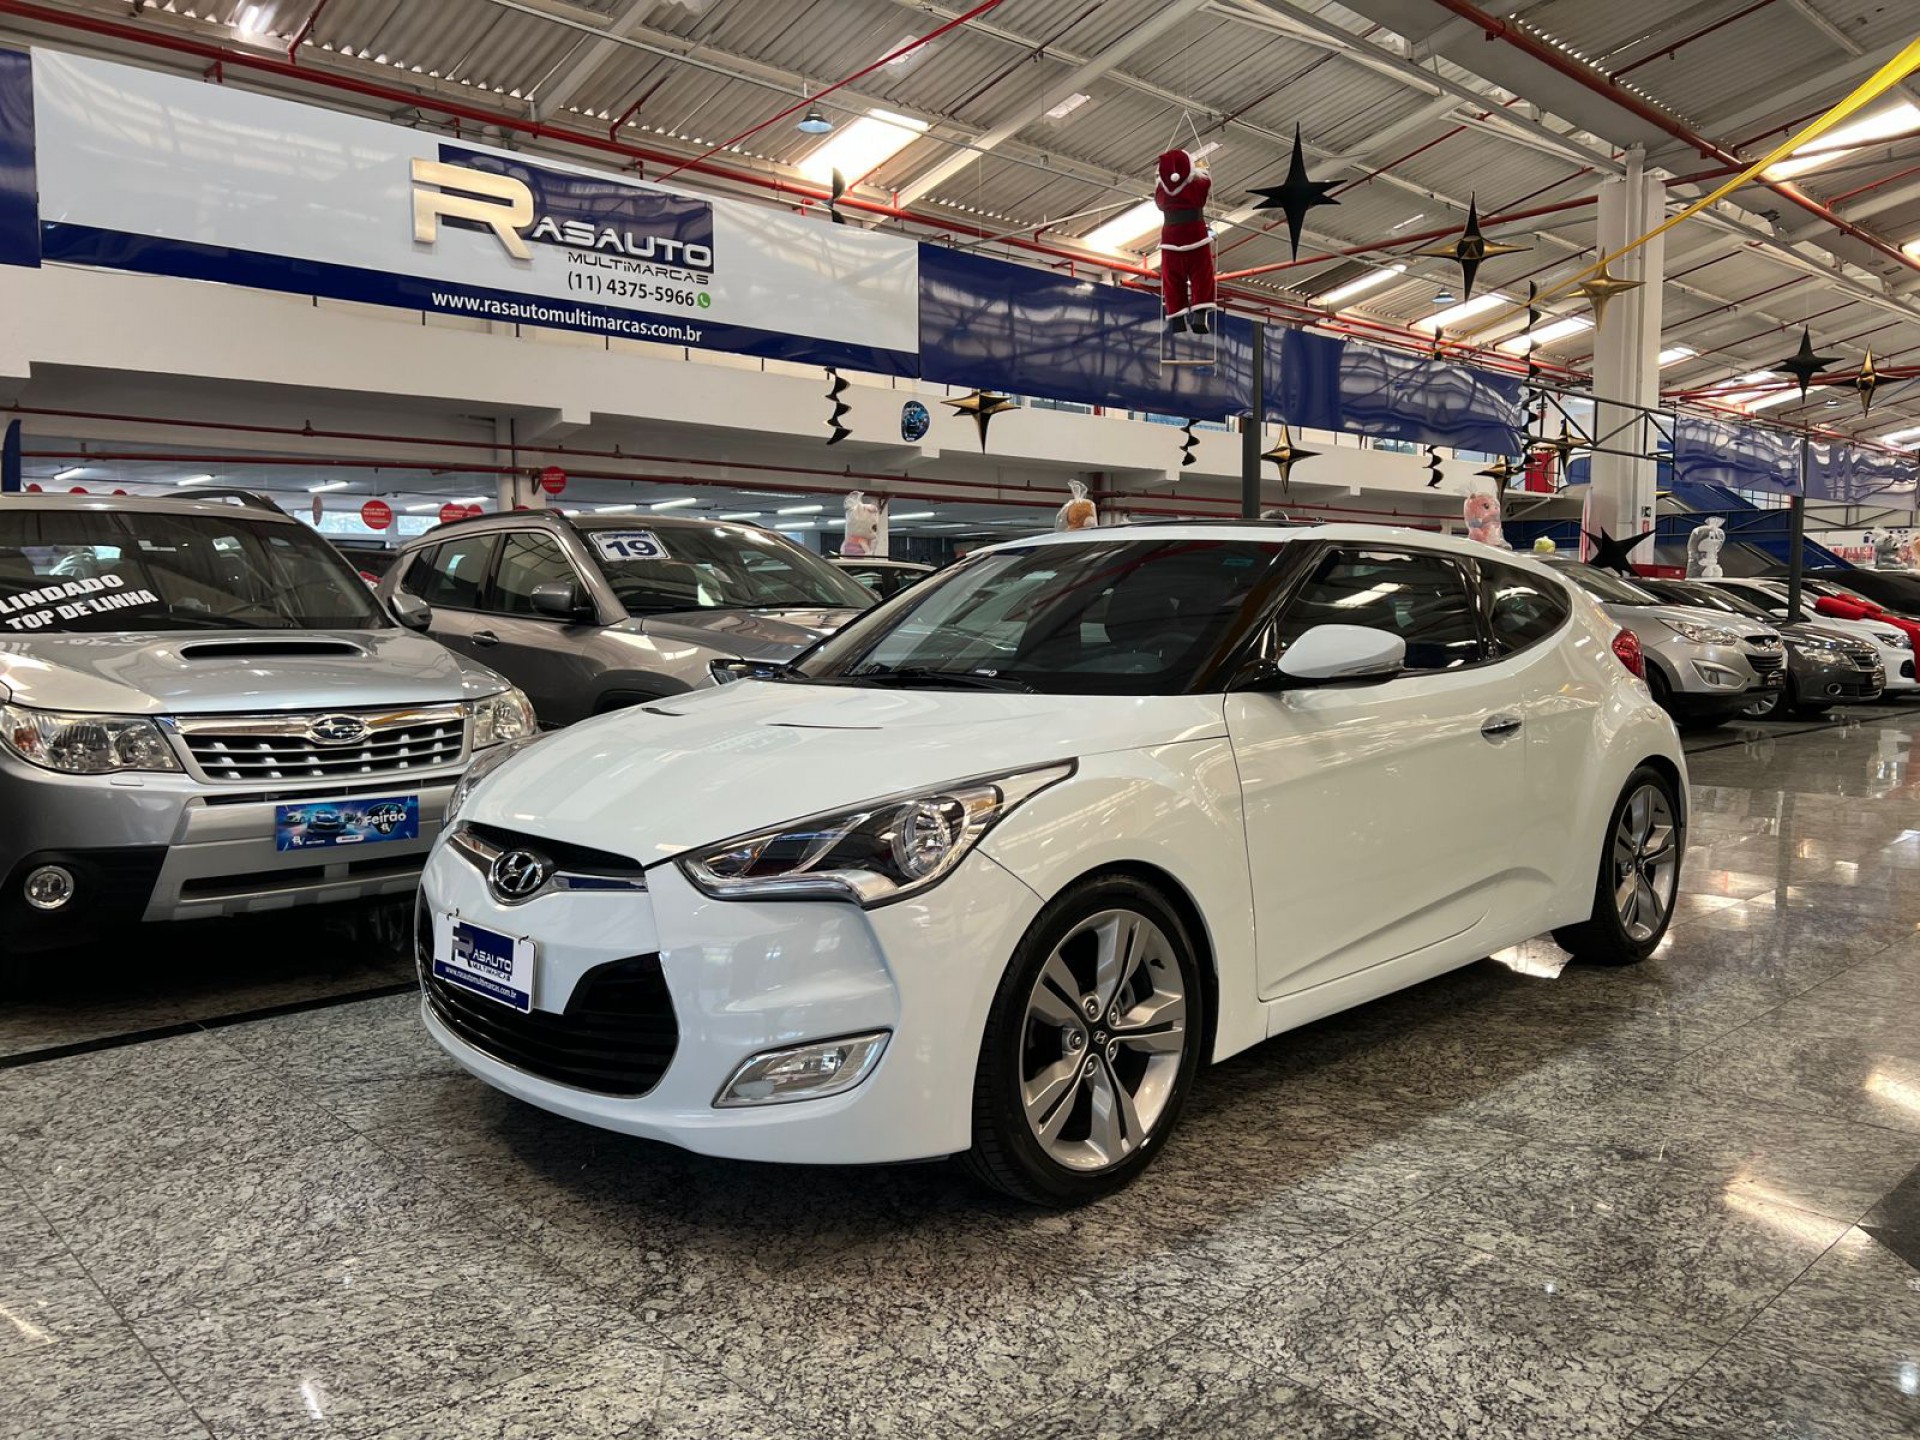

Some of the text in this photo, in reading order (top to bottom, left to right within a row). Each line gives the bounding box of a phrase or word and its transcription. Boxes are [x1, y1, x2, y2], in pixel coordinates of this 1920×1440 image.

[568, 271, 695, 307] (11) 4375-5966
[432, 292, 703, 343] www.rasautomultimarcas.com.br
[606, 540, 658, 557] 19
[5, 589, 160, 630] TOP DE LINHA
[365, 808, 407, 826] Feirão
